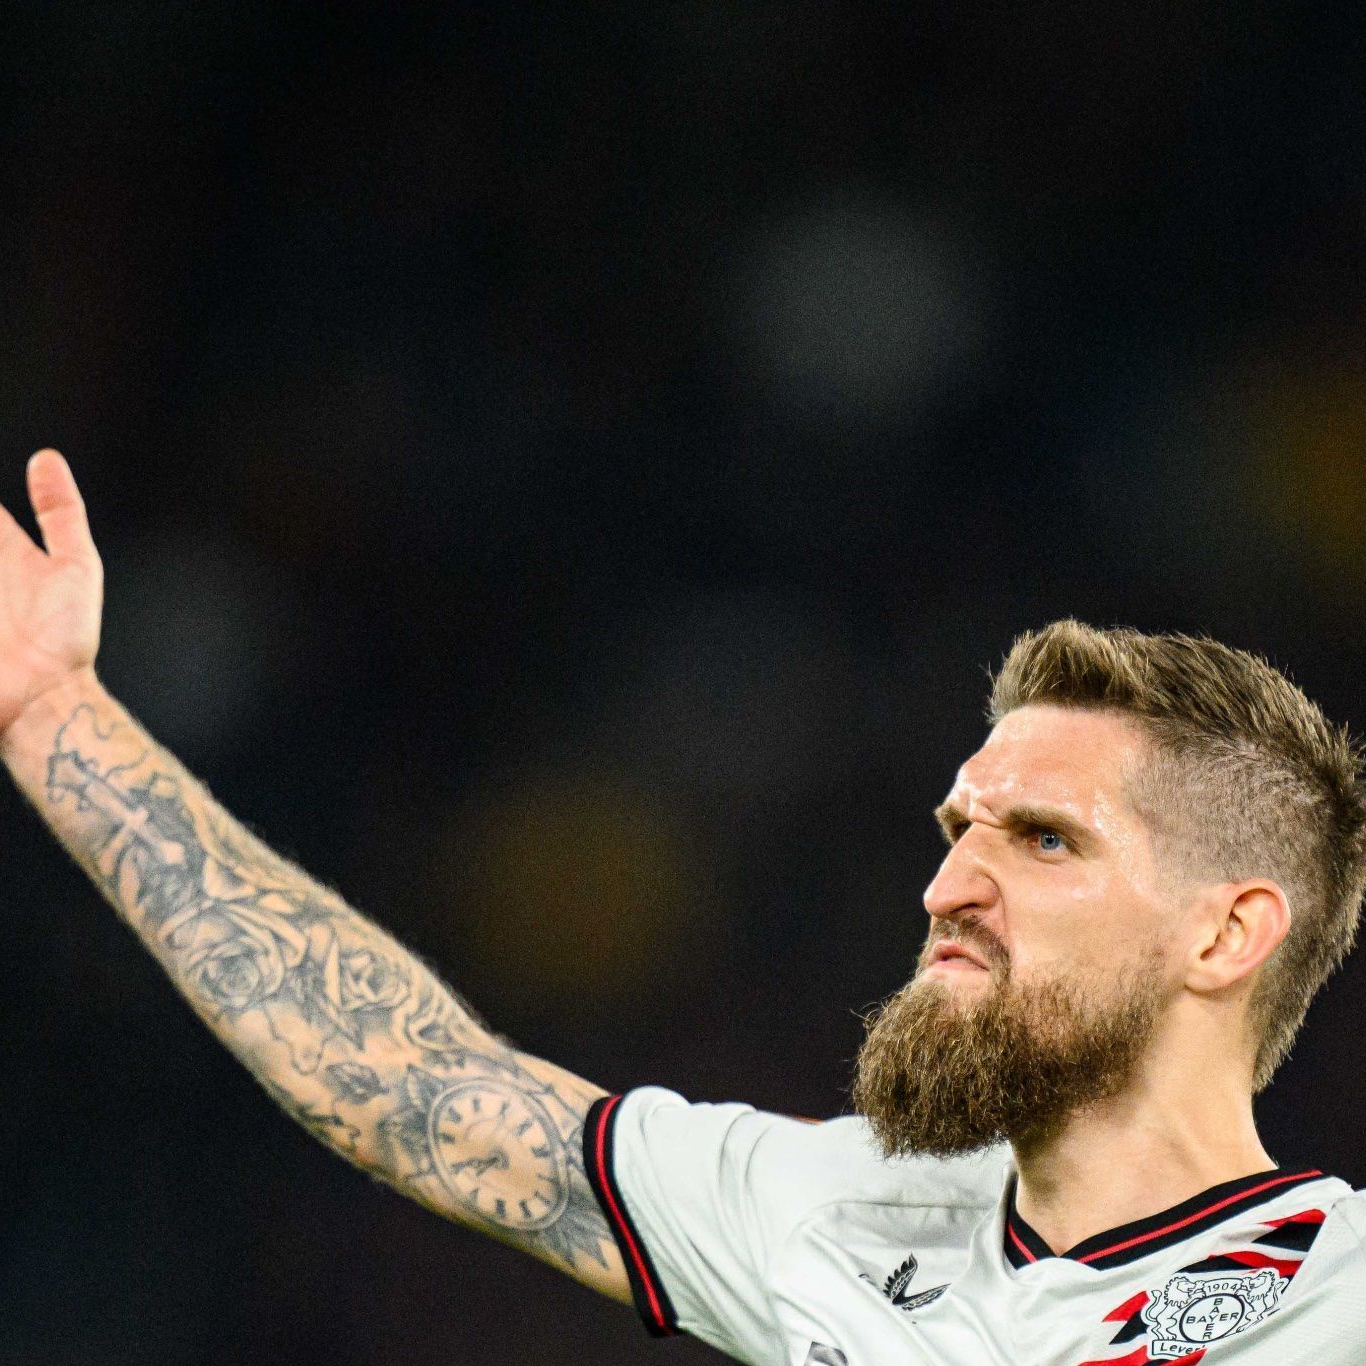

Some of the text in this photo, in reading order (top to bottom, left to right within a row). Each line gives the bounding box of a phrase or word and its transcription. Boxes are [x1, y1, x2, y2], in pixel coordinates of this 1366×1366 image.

[1207, 1282, 1237, 1293] 1904
[1185, 1312, 1239, 1324] BAYER
[1202, 1297, 1223, 1340] BAYER
